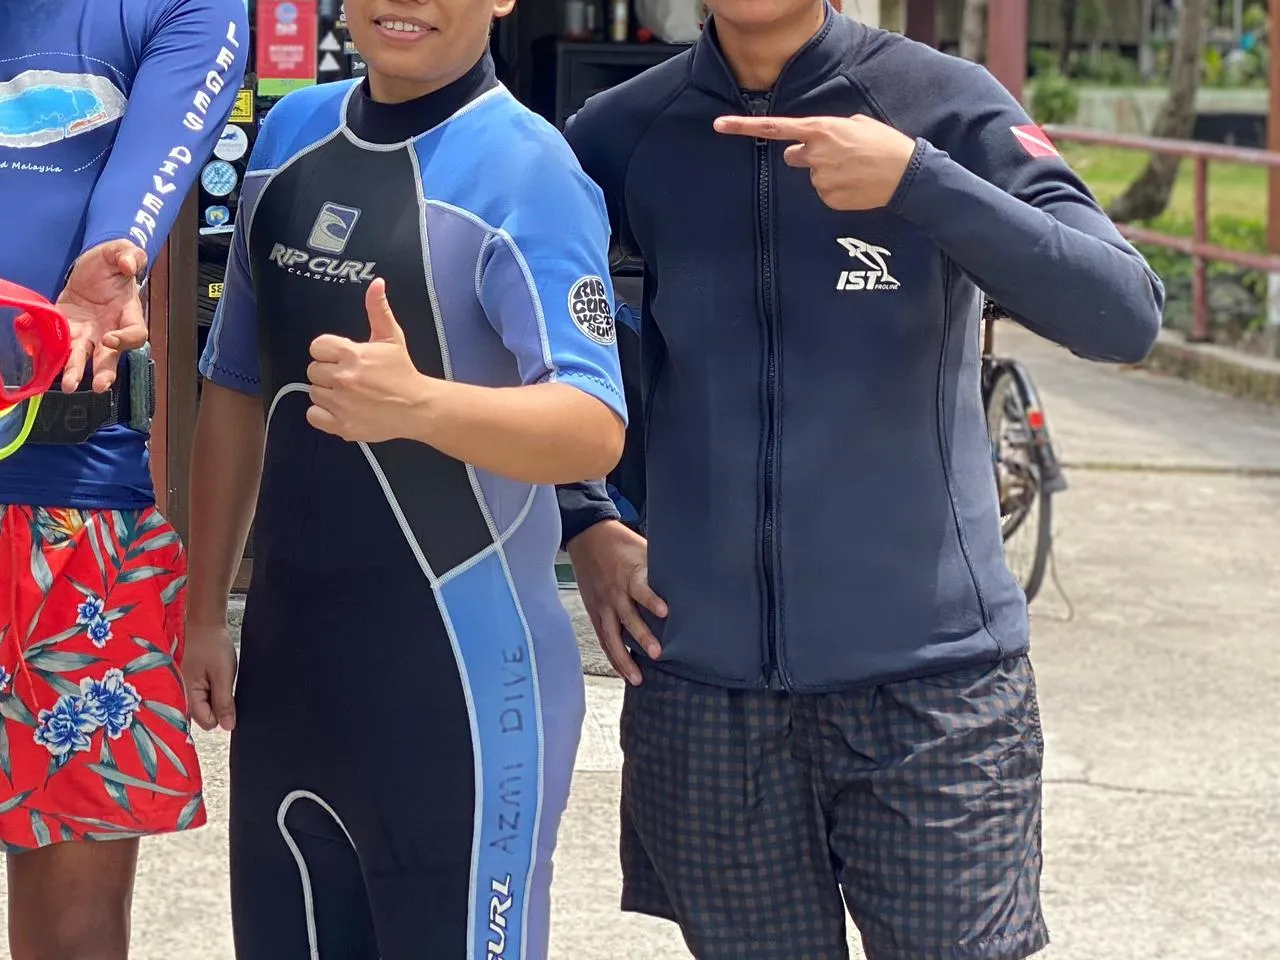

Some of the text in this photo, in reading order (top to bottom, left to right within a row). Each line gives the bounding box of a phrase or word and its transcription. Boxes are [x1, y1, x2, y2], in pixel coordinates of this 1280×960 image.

[182, 20, 240, 131] LEGES
[12, 161, 63, 173] Malaysia
[129, 145, 192, 249] DIVERS
[269, 242, 377, 284] RIP CURL
[287, 267, 347, 284] CLASSIC
[836, 270, 882, 290] IST
[573, 279, 605, 300] RIP
[576, 313, 614, 326] WET
[489, 644, 528, 855] AZMI DIVE
